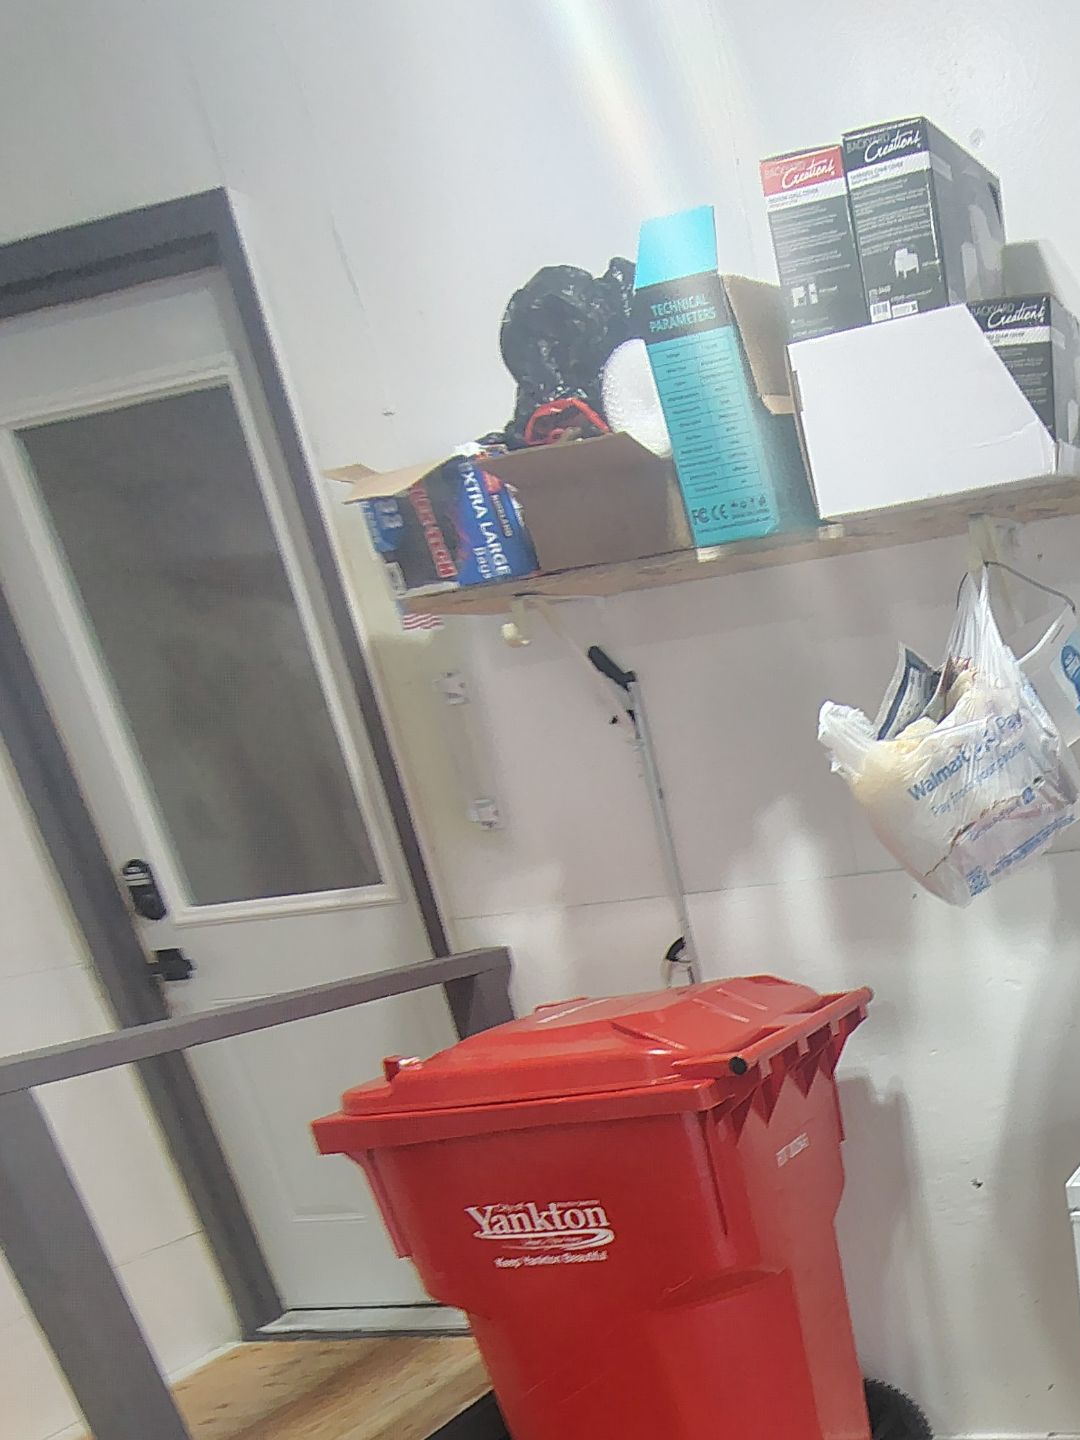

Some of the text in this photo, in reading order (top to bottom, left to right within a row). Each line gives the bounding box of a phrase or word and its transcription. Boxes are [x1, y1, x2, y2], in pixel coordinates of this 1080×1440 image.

[864, 129, 922, 163] Creations
[781, 159, 836, 189] Creations
[649, 306, 716, 332] PARAMETERS
[650, 294, 711, 316] TECHNICAL
[987, 302, 1046, 329] Creations
[480, 521, 512, 576] LARGE
[907, 749, 971, 801] Walmart
[463, 1202, 611, 1236] Yankton
